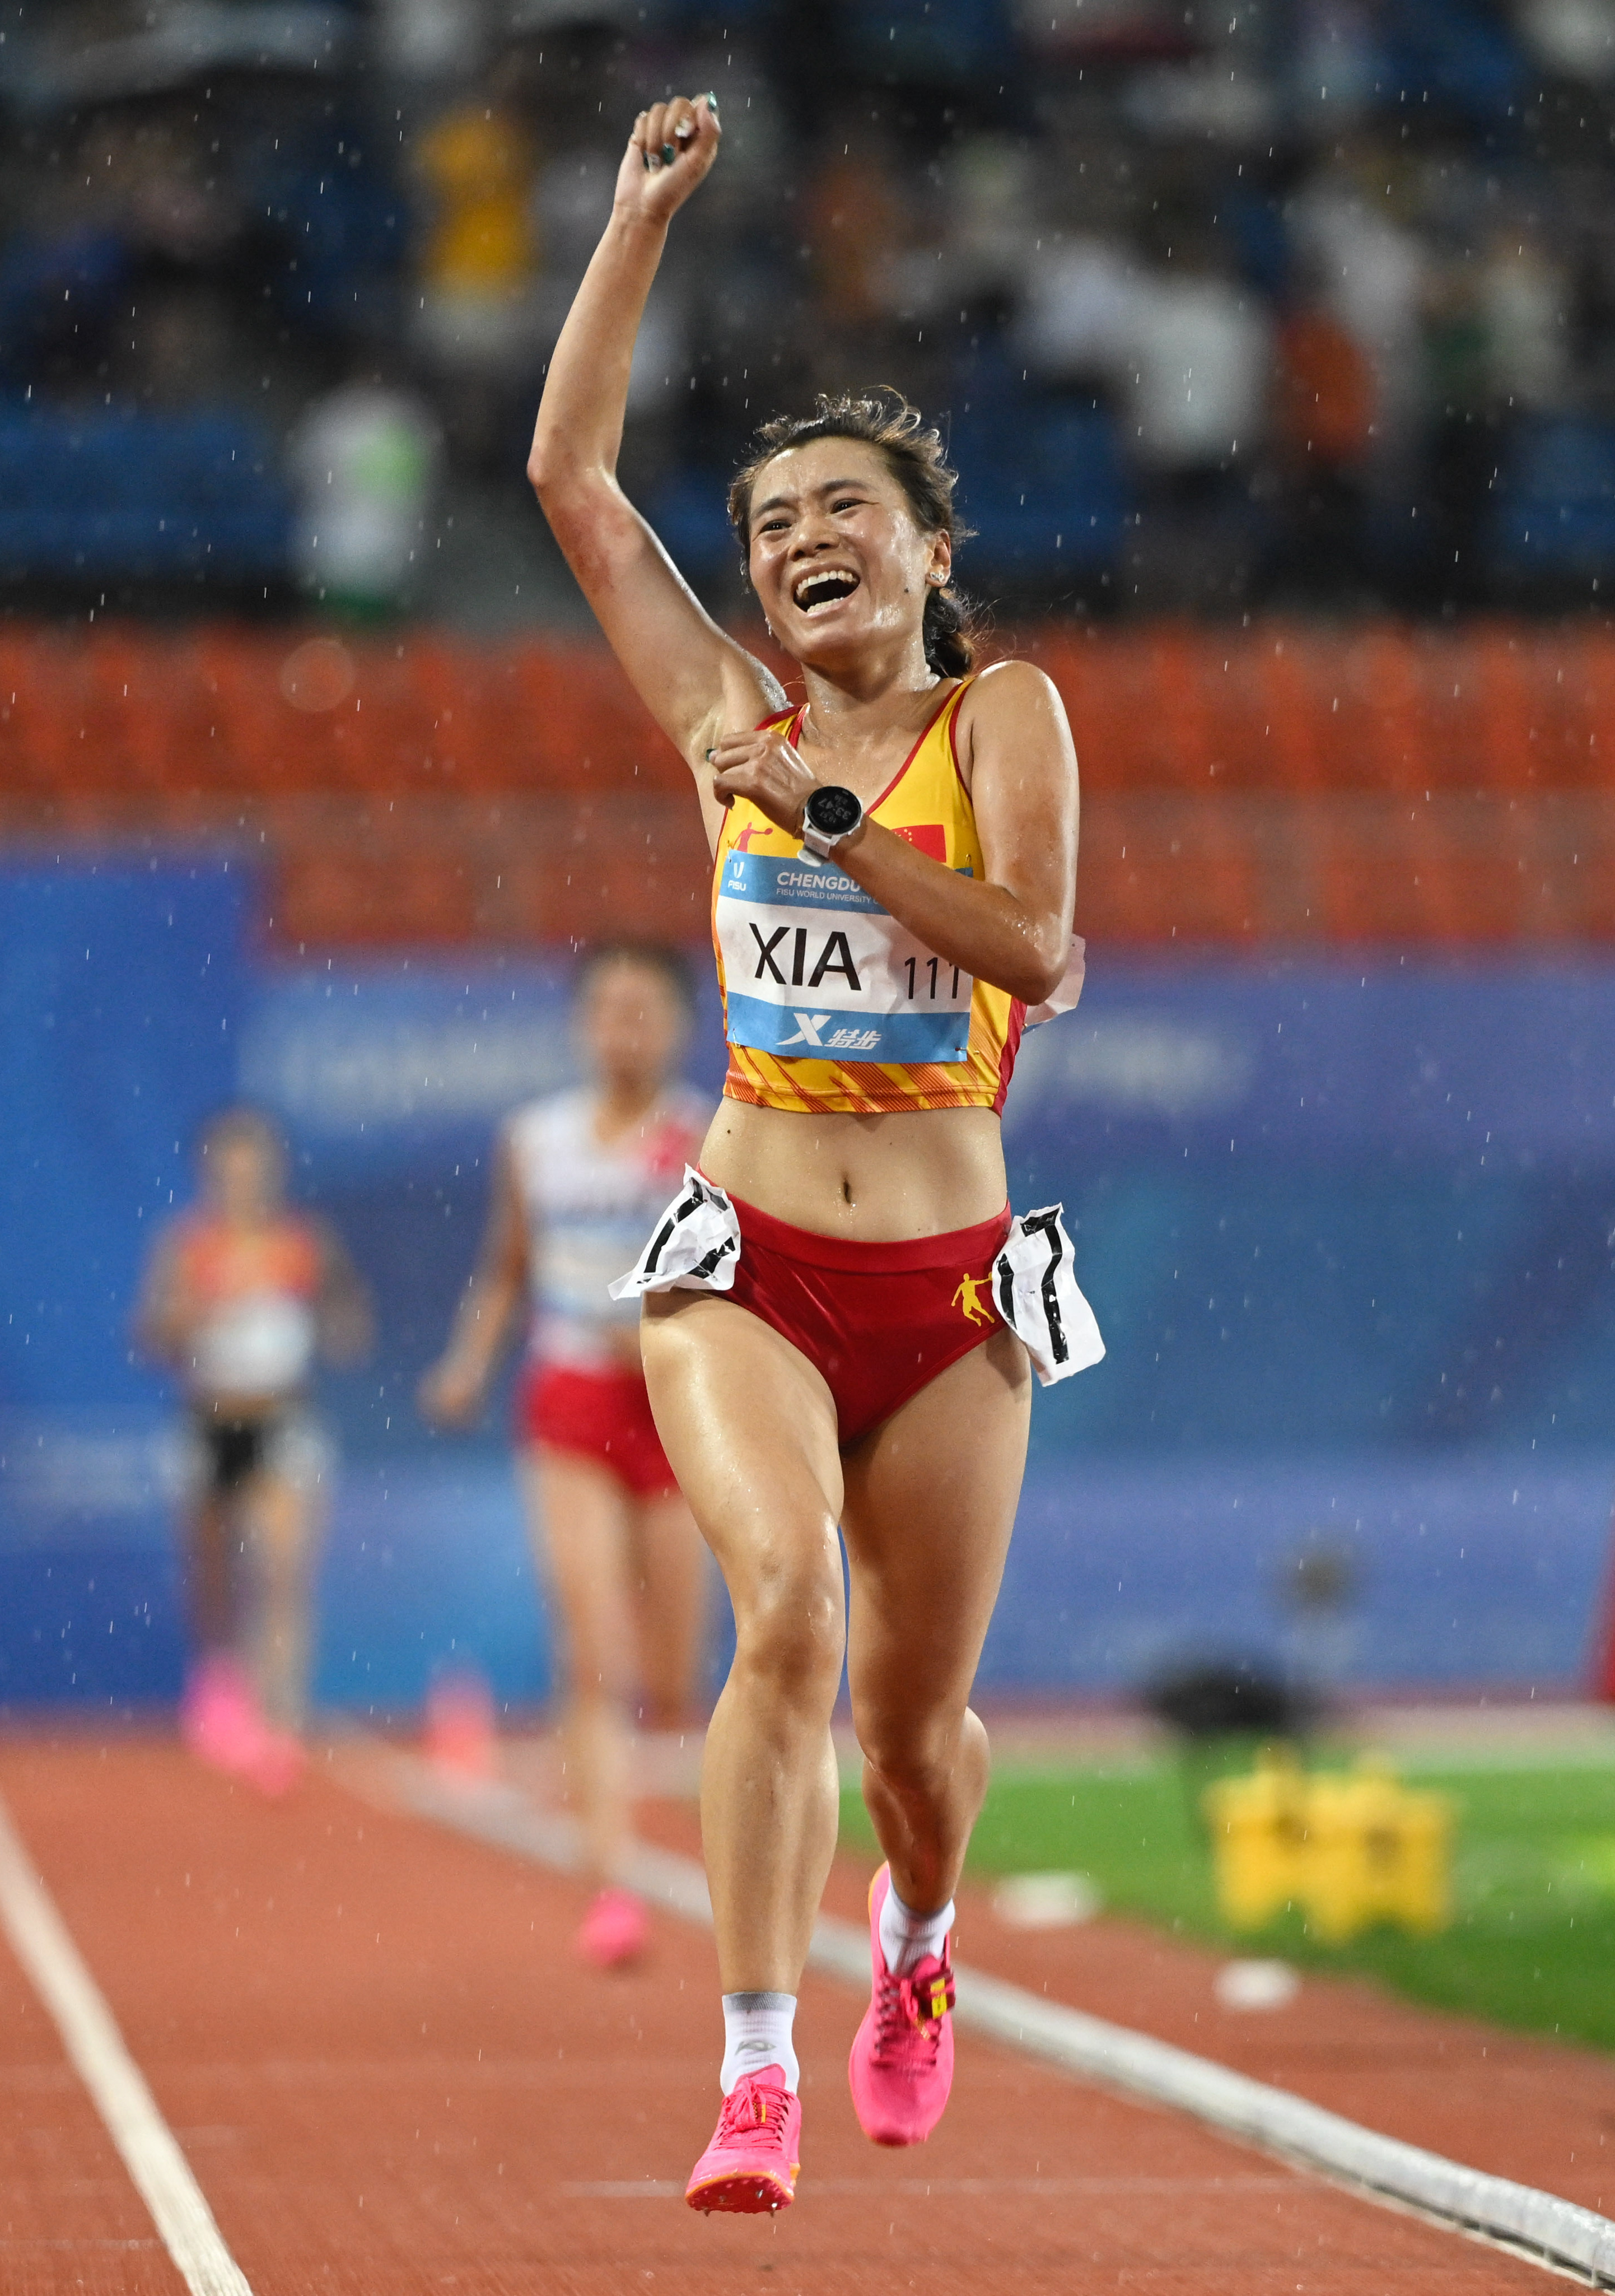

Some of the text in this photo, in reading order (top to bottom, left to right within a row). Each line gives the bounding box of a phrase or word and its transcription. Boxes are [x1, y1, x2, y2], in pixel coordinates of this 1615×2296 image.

[728, 879, 746, 892] FISU
[776, 888, 795, 896] FISU
[796, 889, 825, 899] WORLD
[827, 893, 872, 904] UNIVERSITY
[748, 922, 862, 991] XIA
[824, 1028, 883, 1050] 特步
